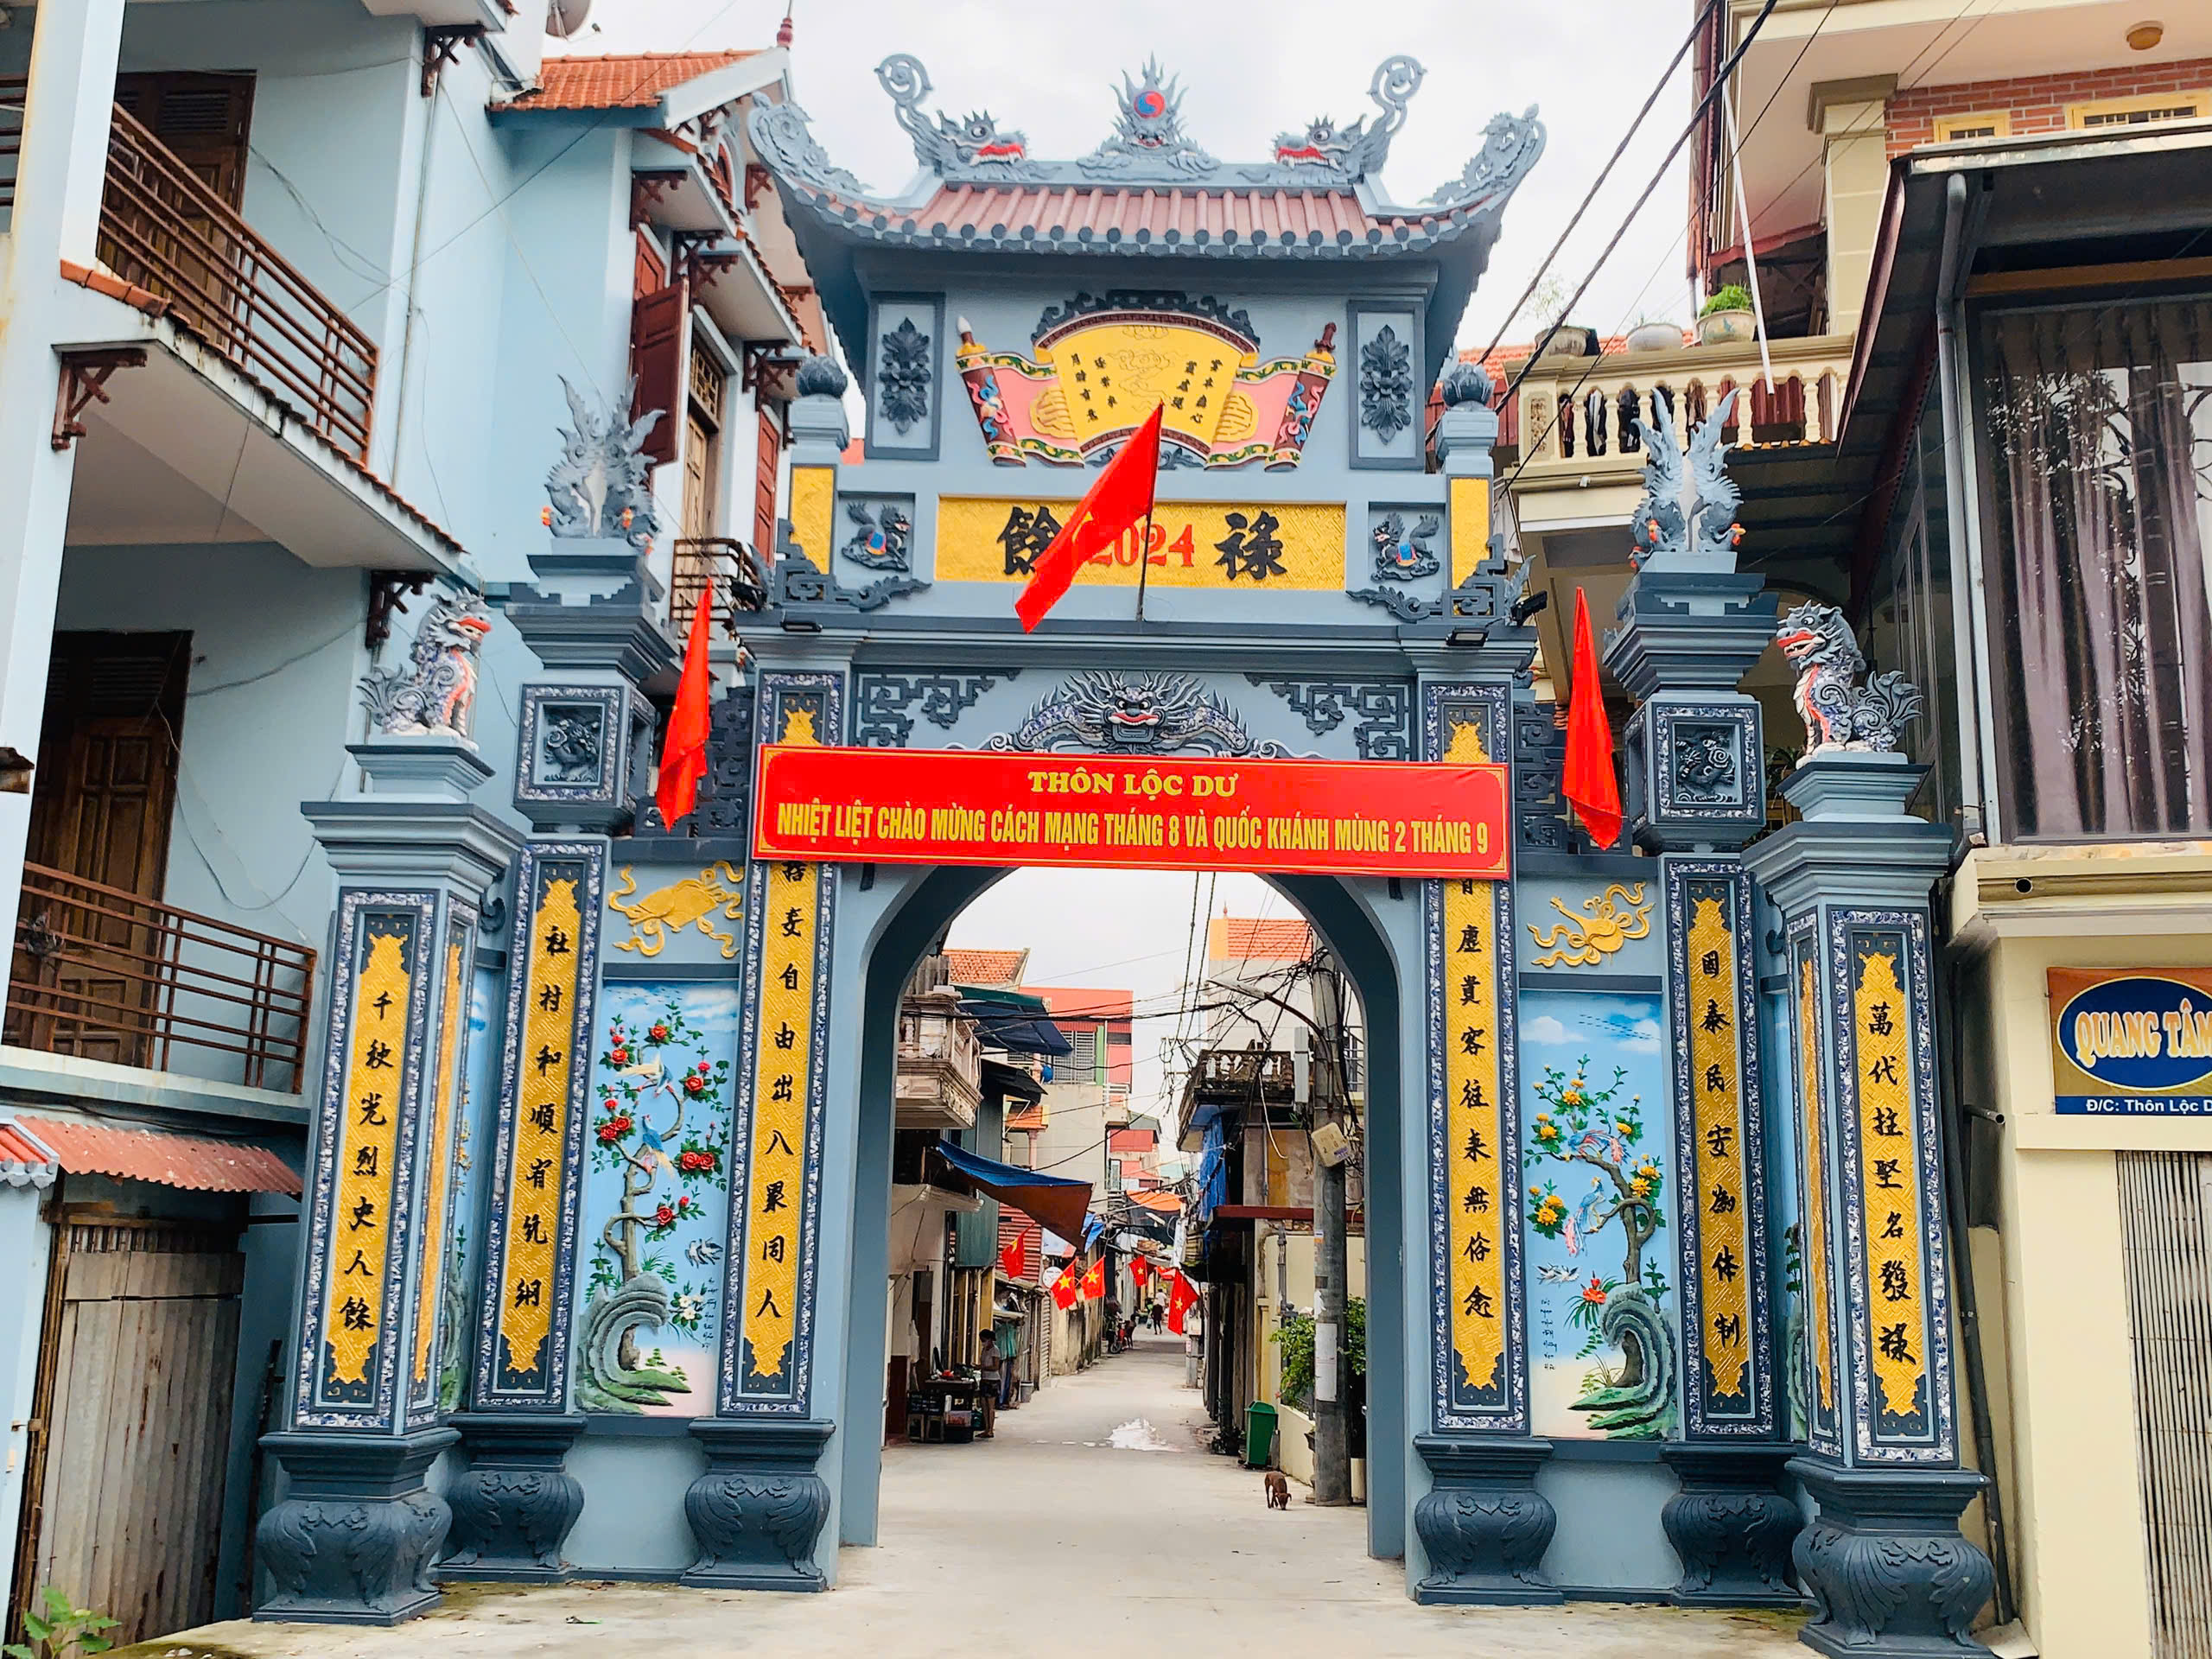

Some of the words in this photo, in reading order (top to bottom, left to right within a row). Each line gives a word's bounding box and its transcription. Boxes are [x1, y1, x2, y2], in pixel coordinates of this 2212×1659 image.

[1027, 766, 1116, 794] THÔN
[1123, 767, 1183, 801] LỘC
[1192, 772, 1239, 798] DƯ
[777, 797, 832, 844] NHIỆT
[835, 798, 873, 845] LIỆT
[877, 801, 926, 842] CHÀO
[931, 802, 986, 842] MỪNG
[990, 804, 1039, 844] CÁCH
[1044, 810, 1099, 851] MẠNG
[1103, 807, 1164, 847] THÁNG
[1168, 815, 1179, 847] 8
[1185, 808, 1209, 847] VÀ
[1213, 804, 1262, 851] QUỐC
[1267, 810, 1329, 851] KHÁNH
[1334, 812, 1389, 853] MÙNG
[1394, 820, 1407, 853] 2
[1410, 814, 1471, 855] THÁNG
[1476, 822, 1489, 855] 9
[2075, 1011, 2162, 1068] QUANG
[2086, 1099, 2120, 1112] Đ/C:
[2125, 1099, 2164, 1112] Thôn
[2170, 1099, 2199, 1115] Lộc
